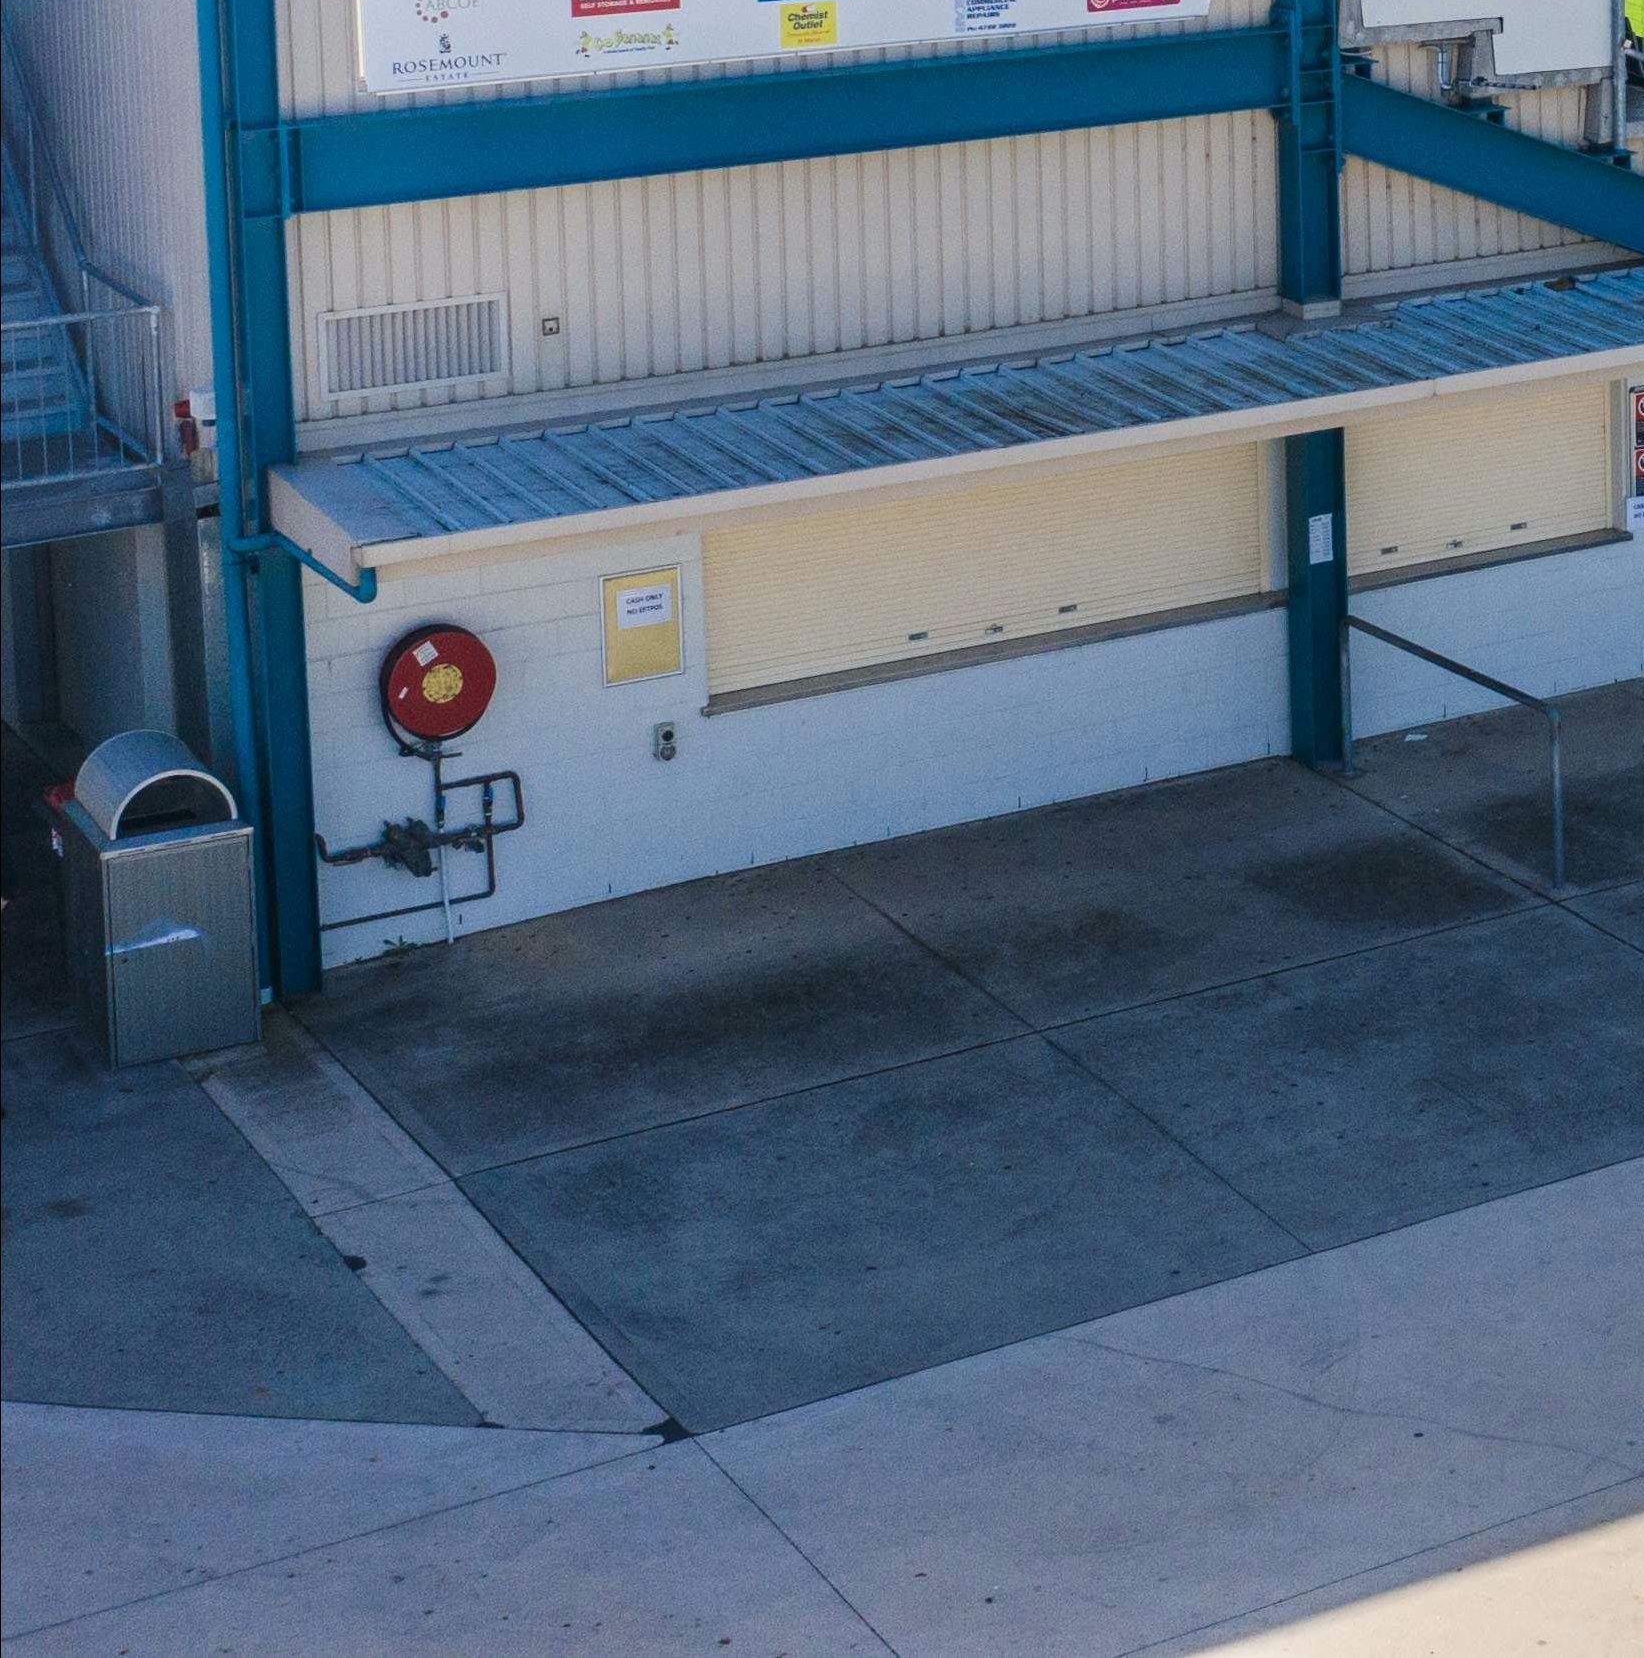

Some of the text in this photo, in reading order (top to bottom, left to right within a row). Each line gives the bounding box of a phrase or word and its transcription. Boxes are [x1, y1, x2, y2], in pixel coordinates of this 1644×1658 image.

[787, 10, 828, 22] Chemist
[793, 19, 824, 31] Outlet
[392, 53, 505, 76] ROSEMOUNT
[425, 72, 470, 82] ESTATE
[626, 592, 664, 605] CASH ONLY
[626, 606, 638, 615] NO
